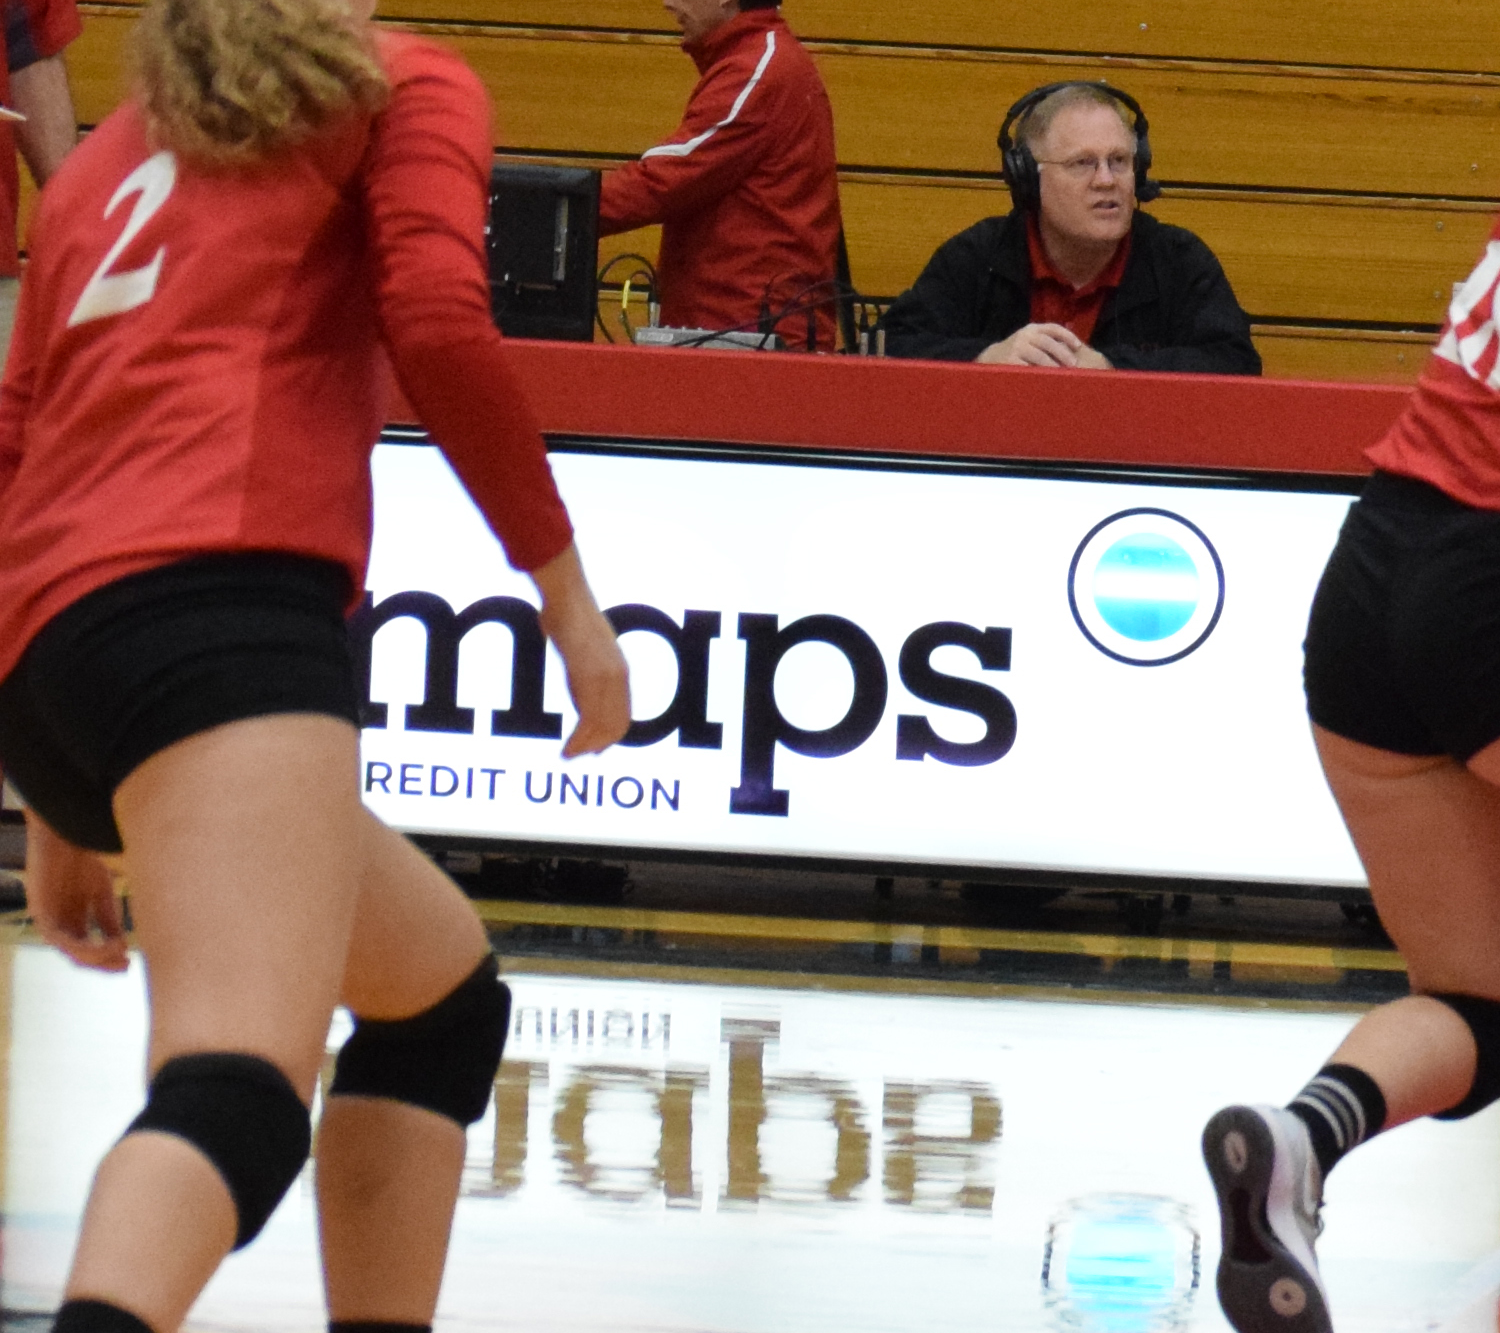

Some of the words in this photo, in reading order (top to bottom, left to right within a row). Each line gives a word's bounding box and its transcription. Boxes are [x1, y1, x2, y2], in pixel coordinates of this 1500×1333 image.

[67, 150, 178, 328] 2
[365, 761, 506, 801] REDIT
[525, 770, 681, 811] UNION
